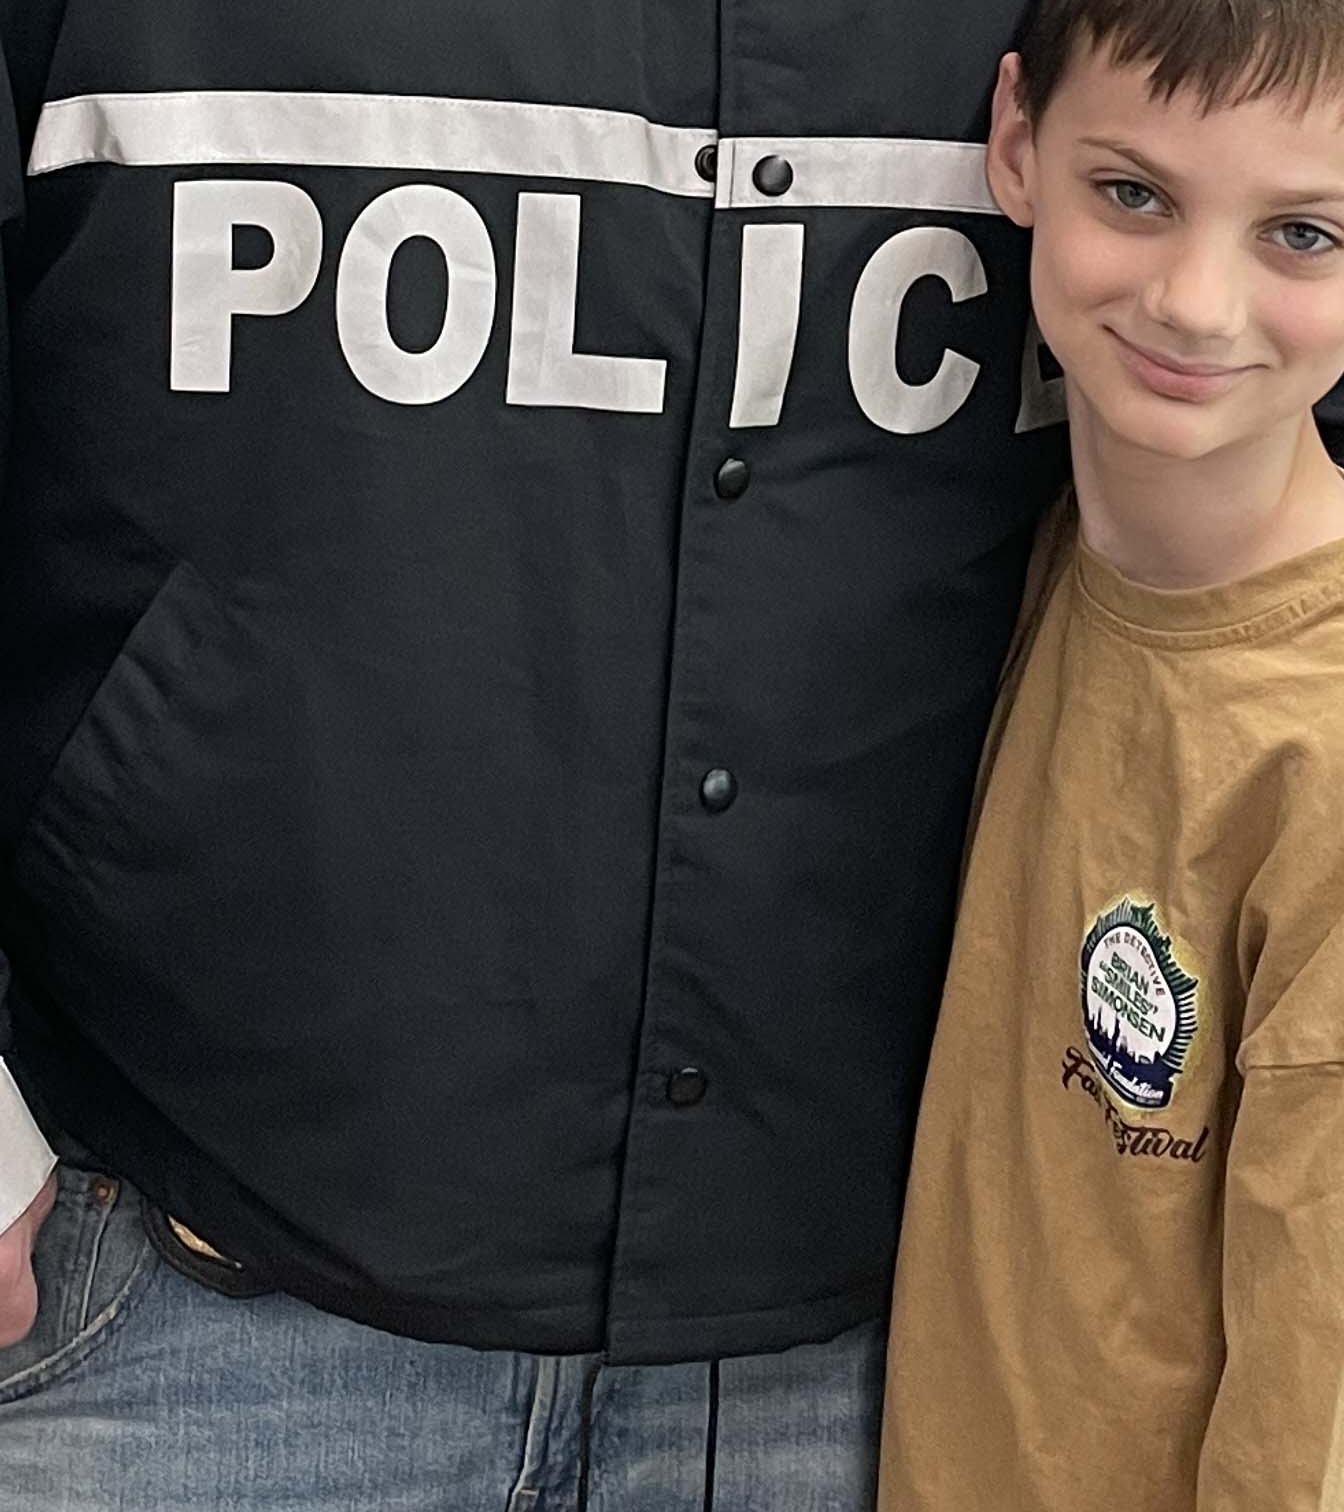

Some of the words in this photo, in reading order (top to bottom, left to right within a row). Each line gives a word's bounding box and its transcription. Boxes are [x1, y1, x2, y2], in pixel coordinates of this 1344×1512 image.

[169, 179, 1069, 435] POLIC
[1103, 932, 1122, 949] THE
[1123, 931, 1166, 998] DETECTIVE
[1110, 951, 1151, 996] BRIAN
[1090, 974, 1167, 1043] SIMONSEN
